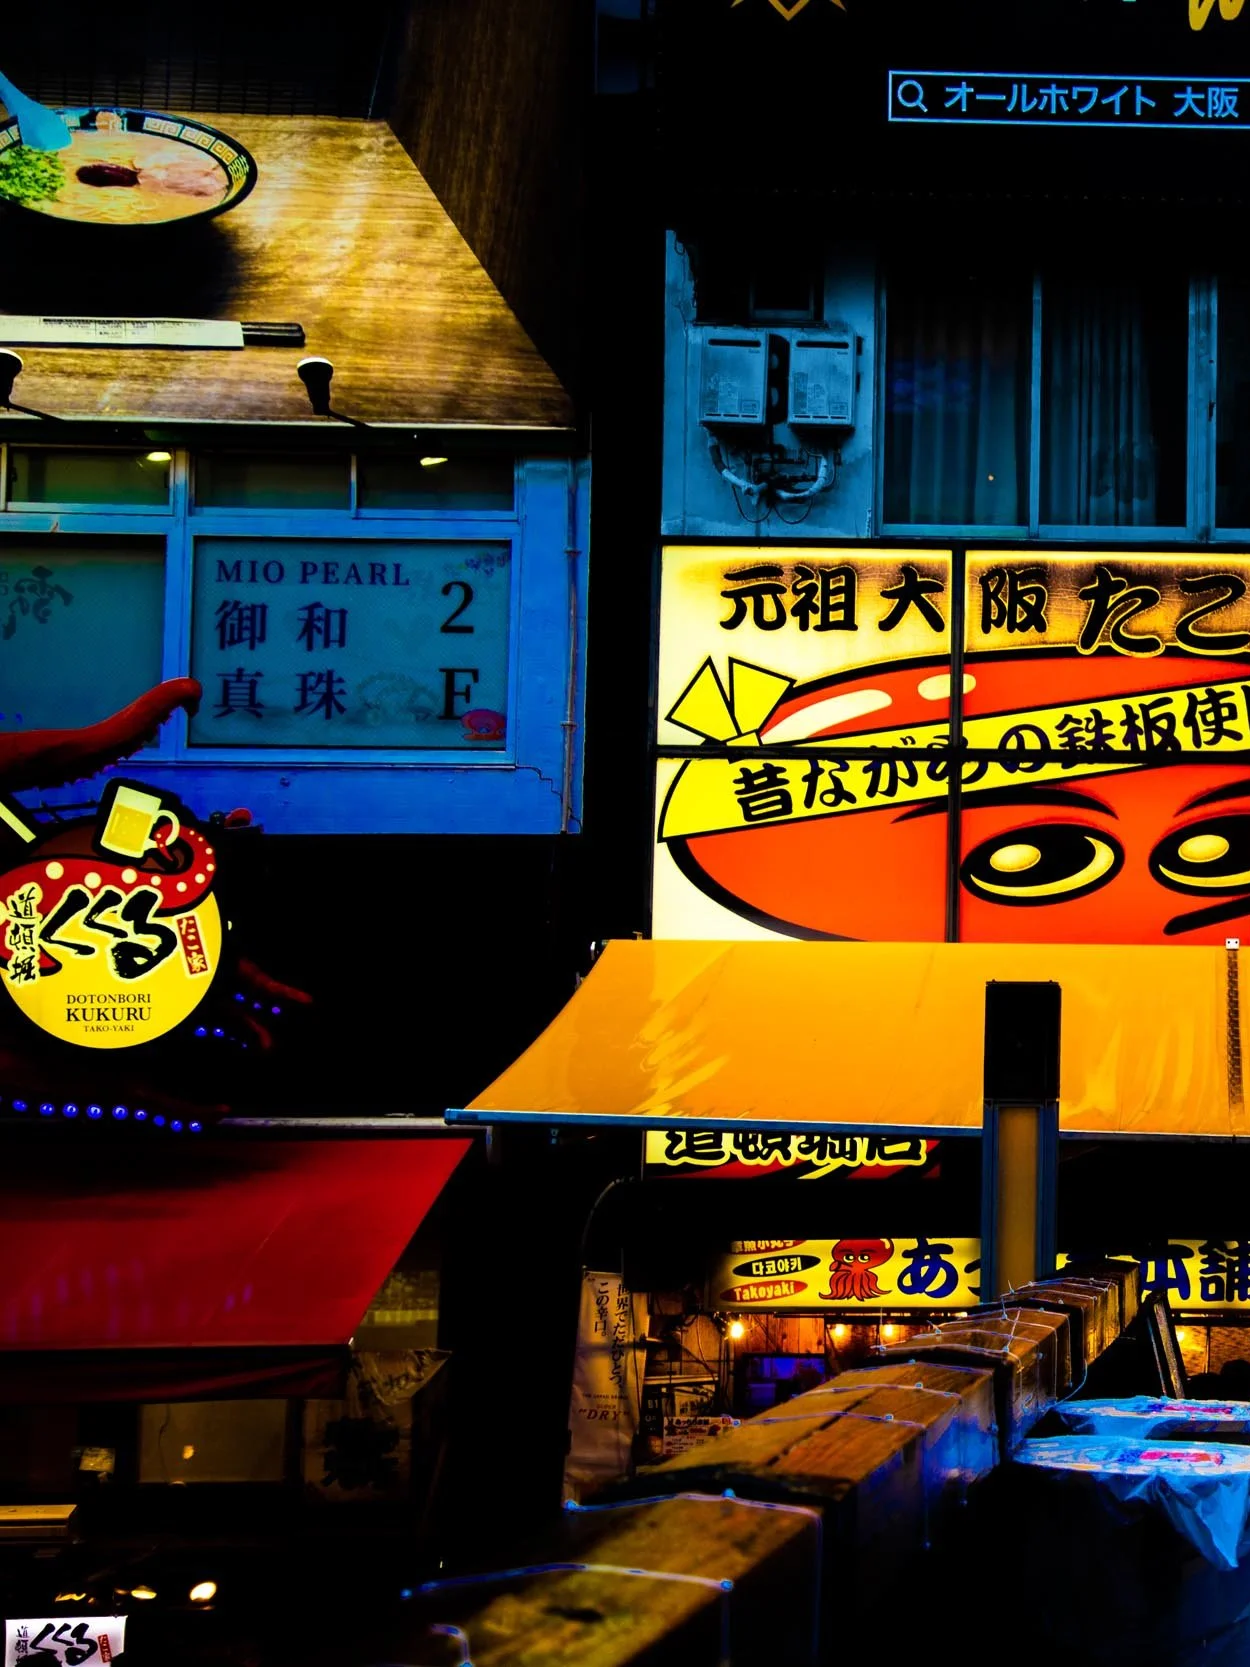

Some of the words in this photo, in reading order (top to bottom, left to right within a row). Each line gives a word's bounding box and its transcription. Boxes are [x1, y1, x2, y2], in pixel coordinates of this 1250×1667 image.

[944, 81, 1156, 116] オールホワイト
[1173, 86, 1239, 119] 大阪
[216, 560, 285, 584] MIO
[300, 560, 410, 586] PEARL
[213, 667, 347, 720] 真珠
[9, 887, 38, 984] 道頓堀
[38, 888, 178, 980] くくる
[65, 1007, 152, 1022] KUKURU
[66, 993, 151, 1004] DOTONBORI
[751, 1257, 802, 1275] 다코야키
[733, 1281, 795, 1301] Takoyaki
[29, 1623, 98, 1666] くくる
